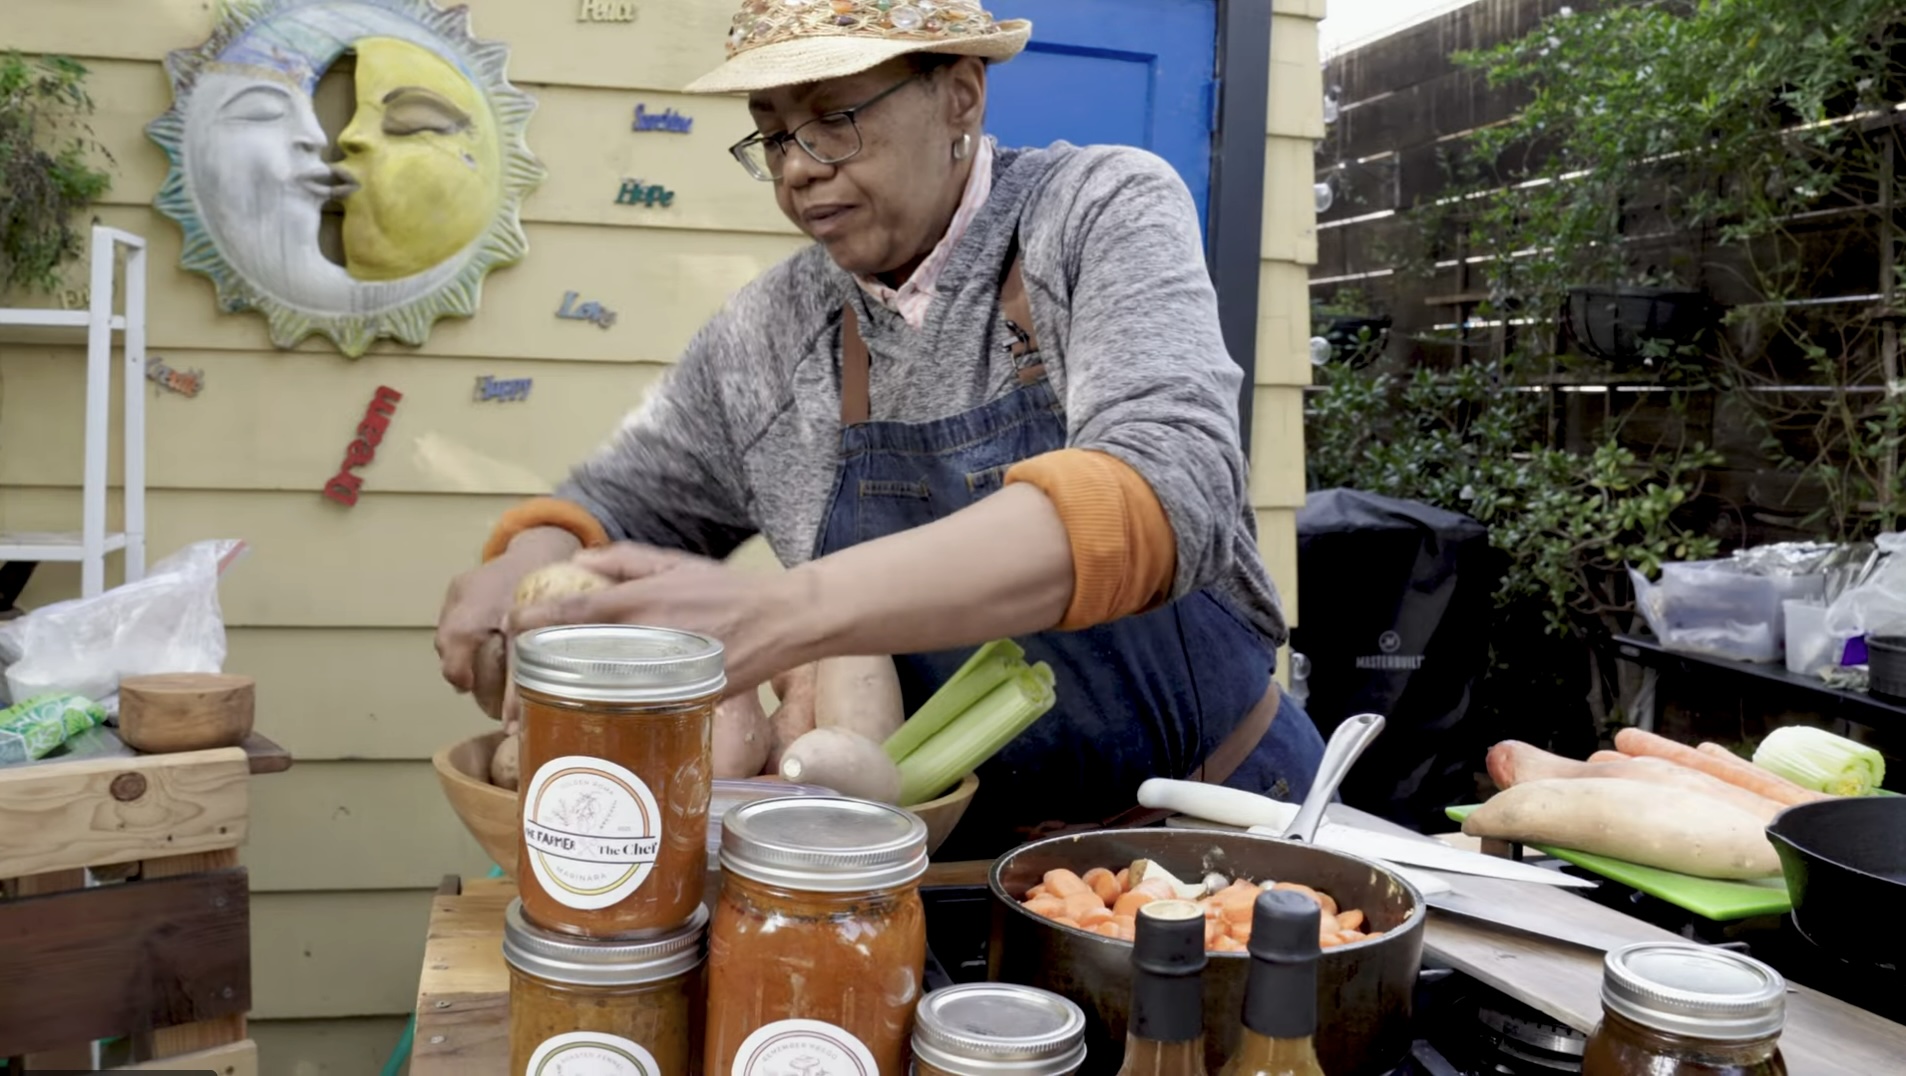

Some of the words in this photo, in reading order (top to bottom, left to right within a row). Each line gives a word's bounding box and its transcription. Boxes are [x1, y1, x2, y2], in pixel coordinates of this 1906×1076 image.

[615, 179, 675, 207] Hope
[324, 385, 403, 507] Dream
[1356, 655, 1425, 669] MASTERBUILT
[537, 831, 576, 850] FARMER
[597, 844, 620, 855] The
[622, 842, 657, 855] Chef
[556, 865, 607, 881] MARINARA
